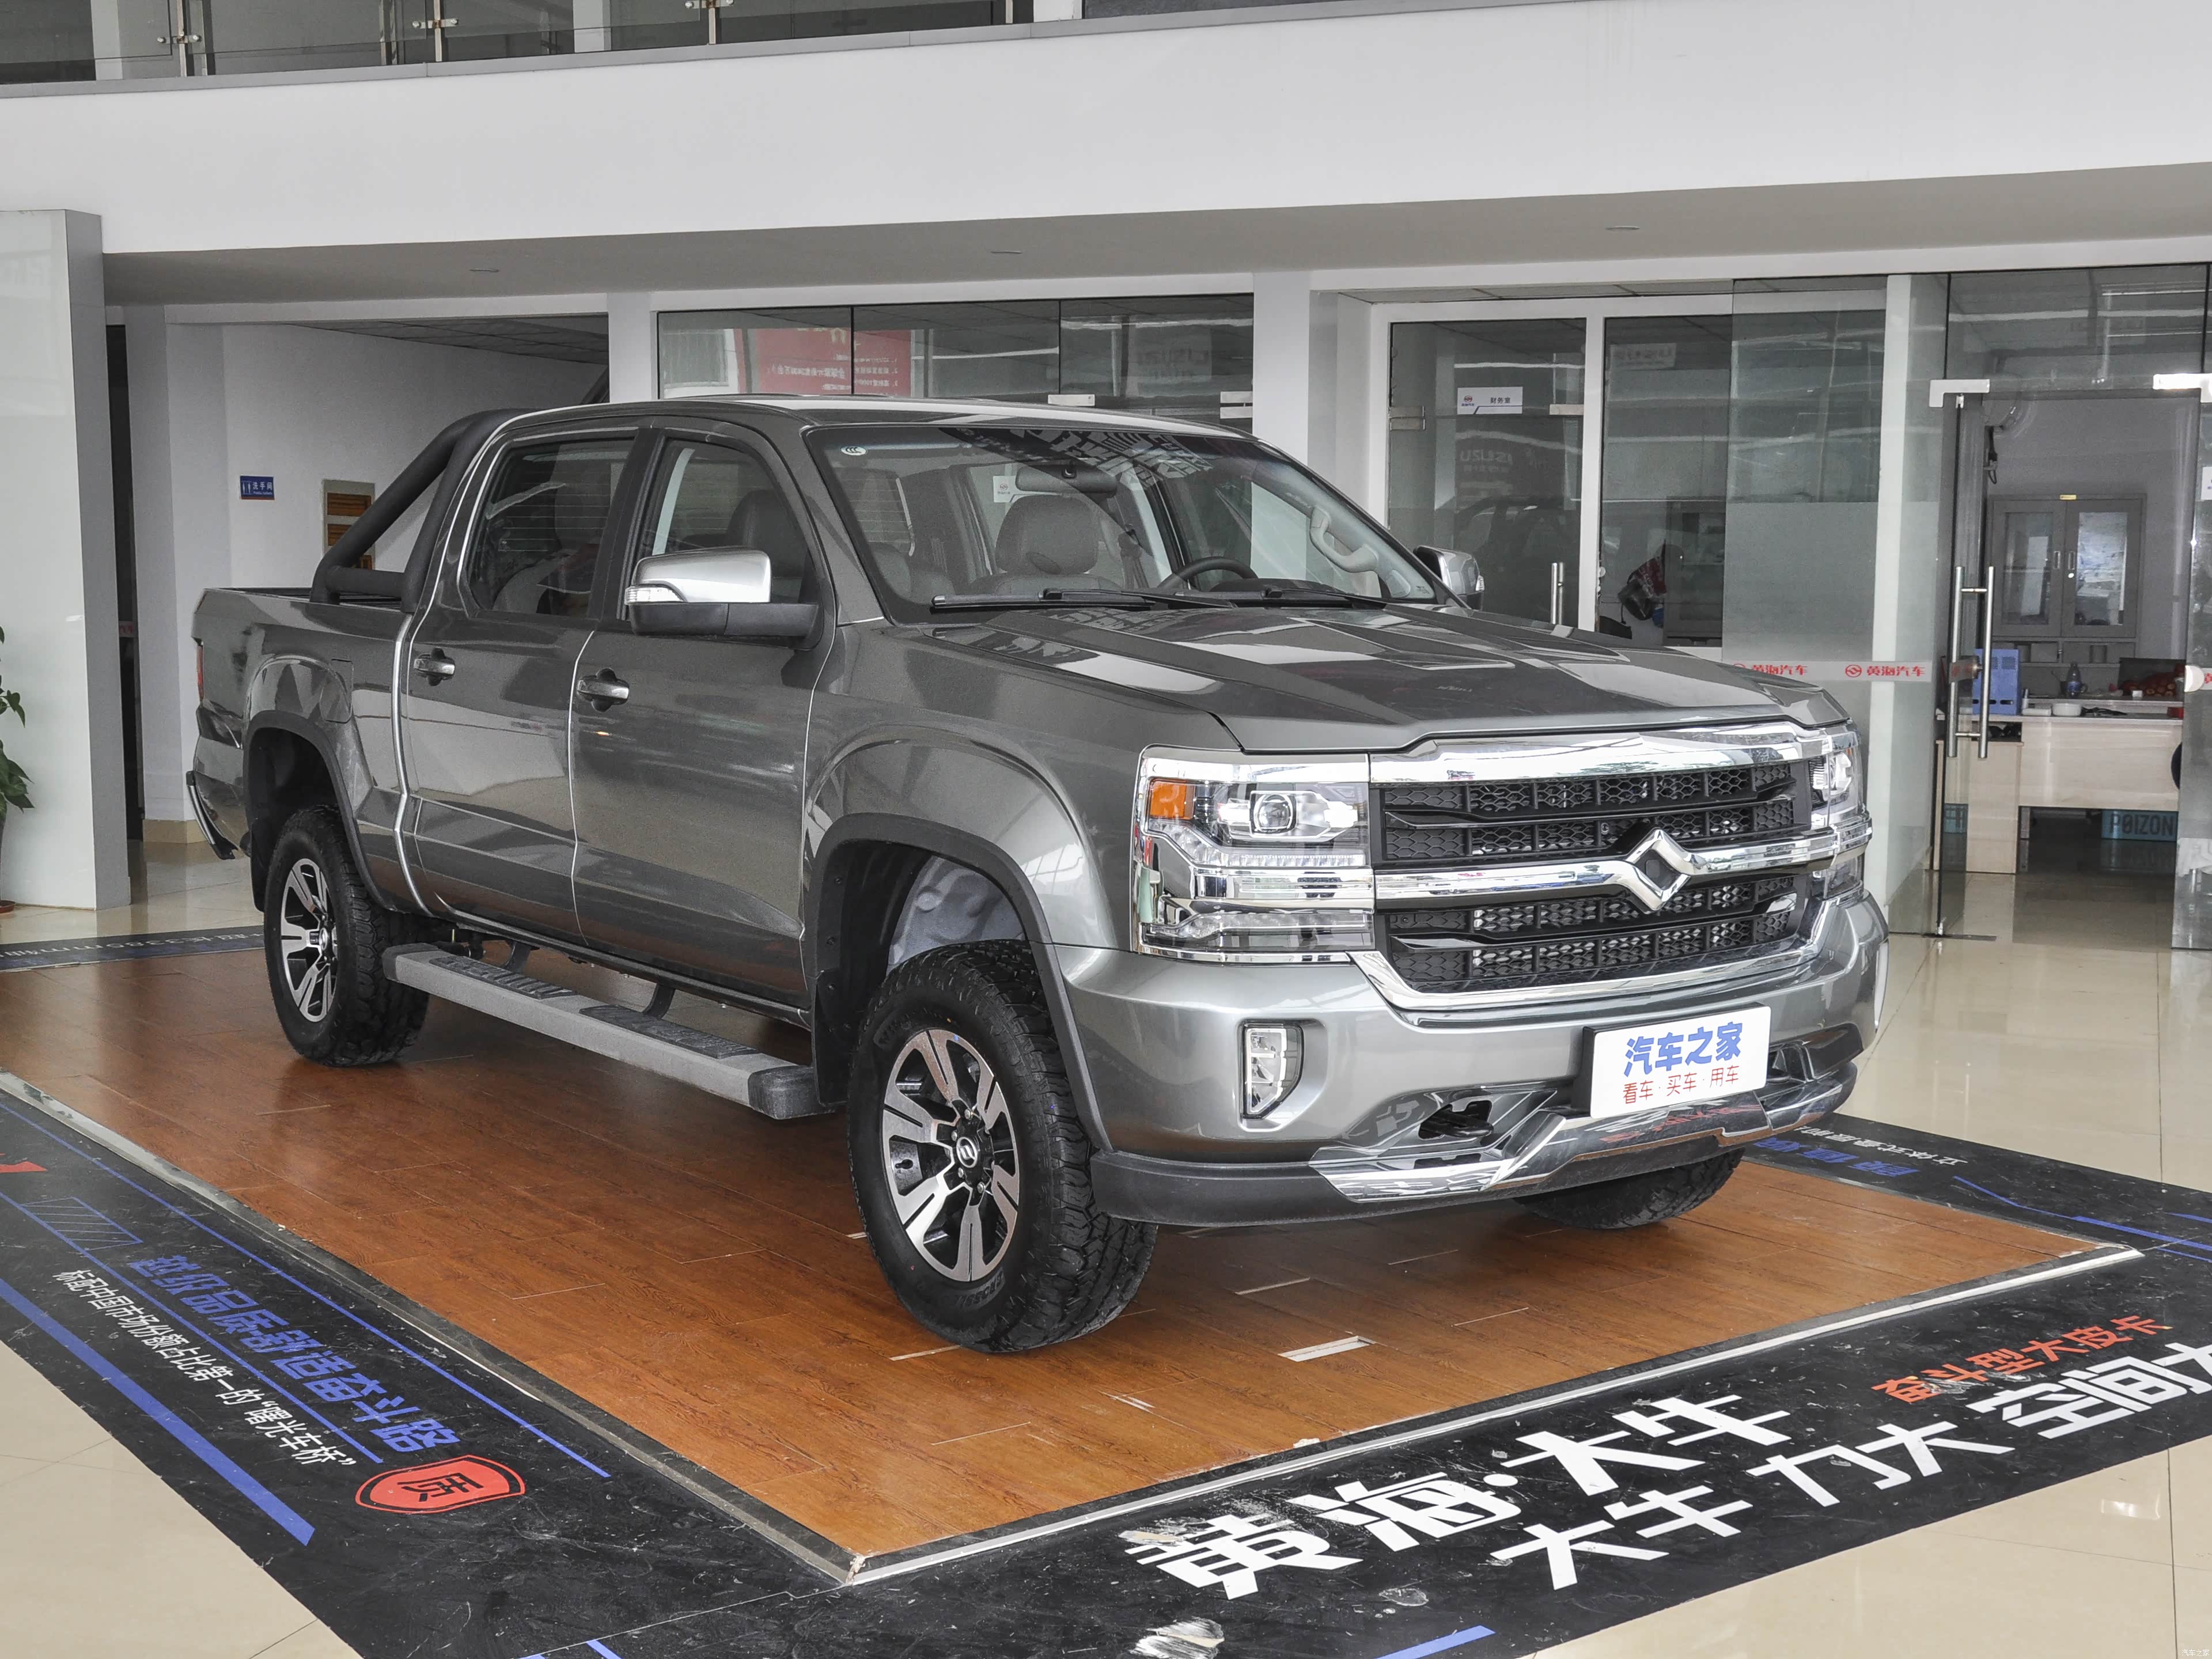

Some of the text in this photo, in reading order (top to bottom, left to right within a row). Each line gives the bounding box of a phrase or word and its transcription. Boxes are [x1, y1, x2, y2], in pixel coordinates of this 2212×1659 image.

[252, 482, 272, 490] 洗手间
[1866, 666, 1925, 676] 黄海汽车
[1624, 1021, 1743, 1077] 汽车之家
[1872, 1315, 2173, 1403] 奋斗型大皮卡
[397, 1472, 484, 1502] 质
